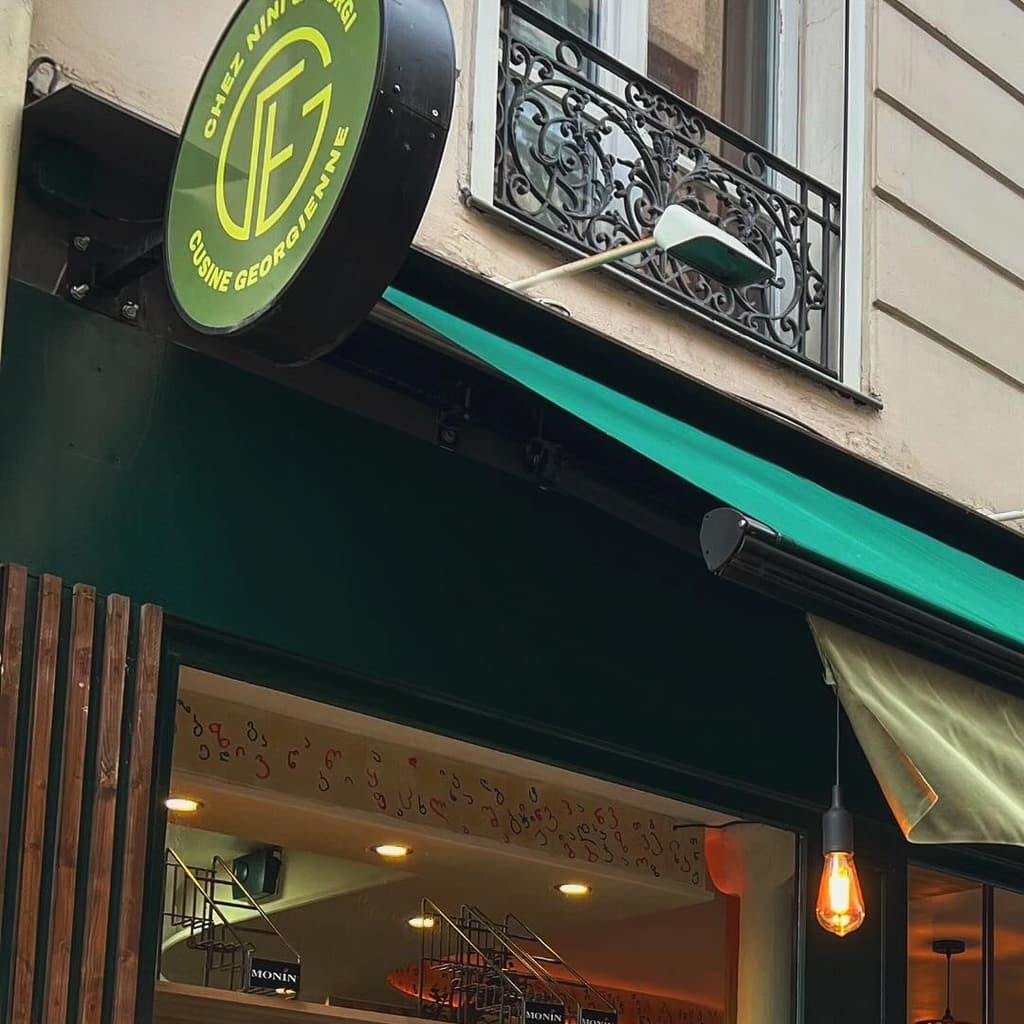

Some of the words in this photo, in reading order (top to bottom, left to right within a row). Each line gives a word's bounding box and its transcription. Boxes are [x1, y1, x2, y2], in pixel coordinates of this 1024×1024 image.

[203, 52, 245, 139] CHEZ
[246, 0, 286, 51] NINI
[188, 229, 233, 293] CUSINE
[233, 125, 350, 291] GEORGIENNE
[251, 968, 297, 983] MONIN
[526, 1010, 562, 1022] MONIN
